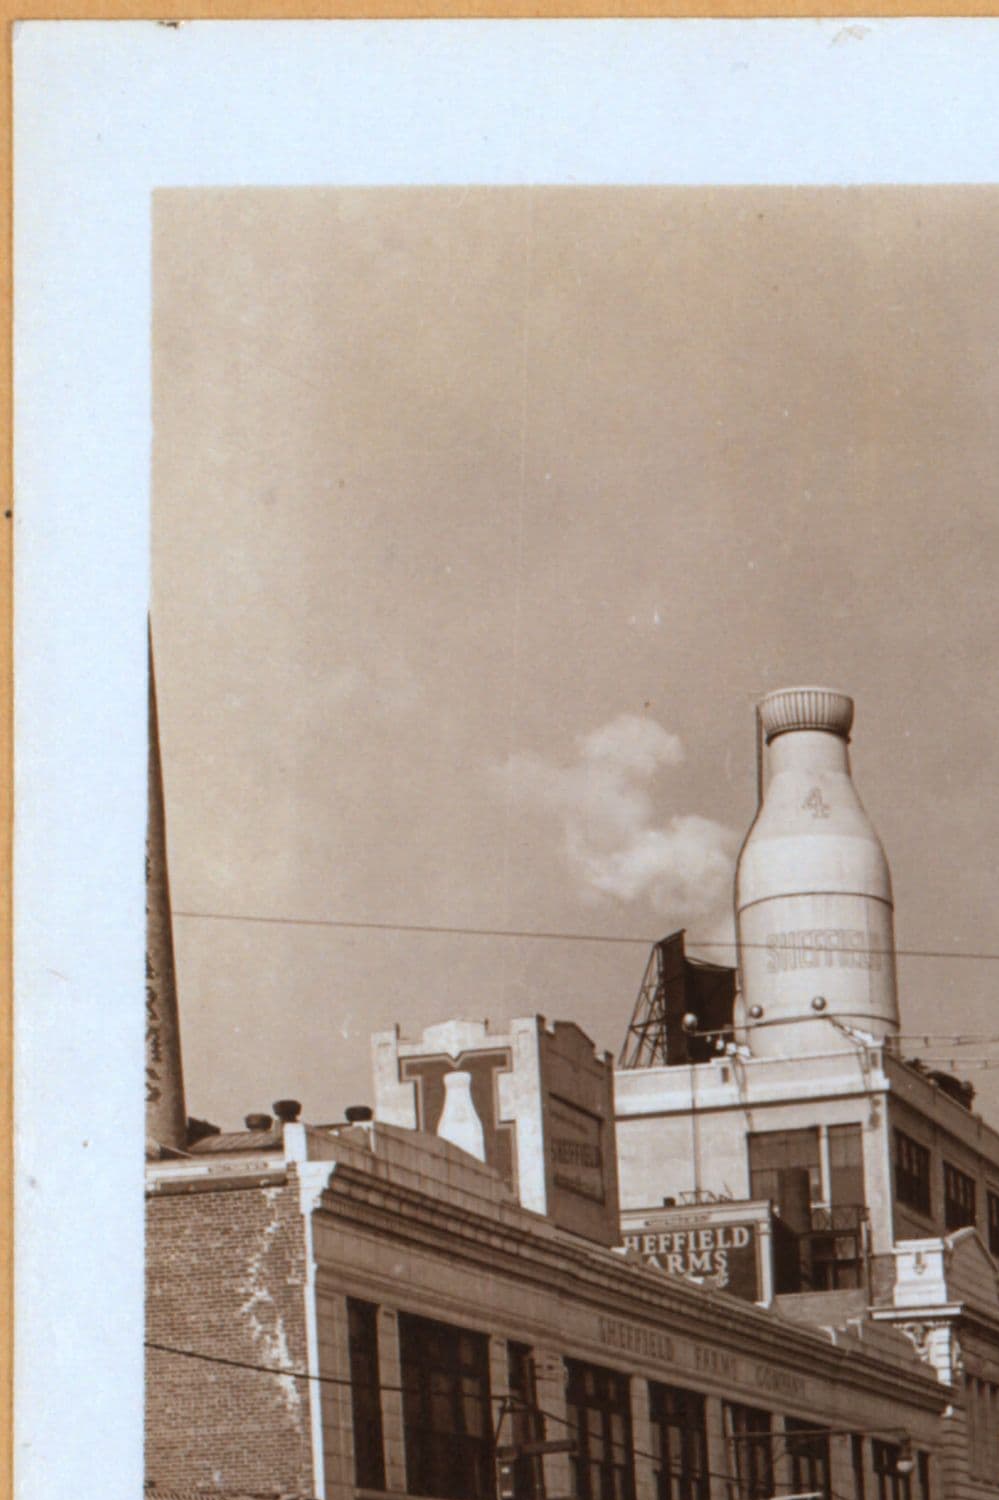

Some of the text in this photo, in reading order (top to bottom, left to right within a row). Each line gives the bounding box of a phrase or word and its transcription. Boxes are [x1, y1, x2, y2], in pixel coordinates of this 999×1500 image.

[767, 927, 881, 973] SHEFFIELD
[623, 1226, 750, 1255] HEFFIELD
[646, 1249, 730, 1274] ARMS
[599, 1314, 674, 1362] SHEFFIELD
